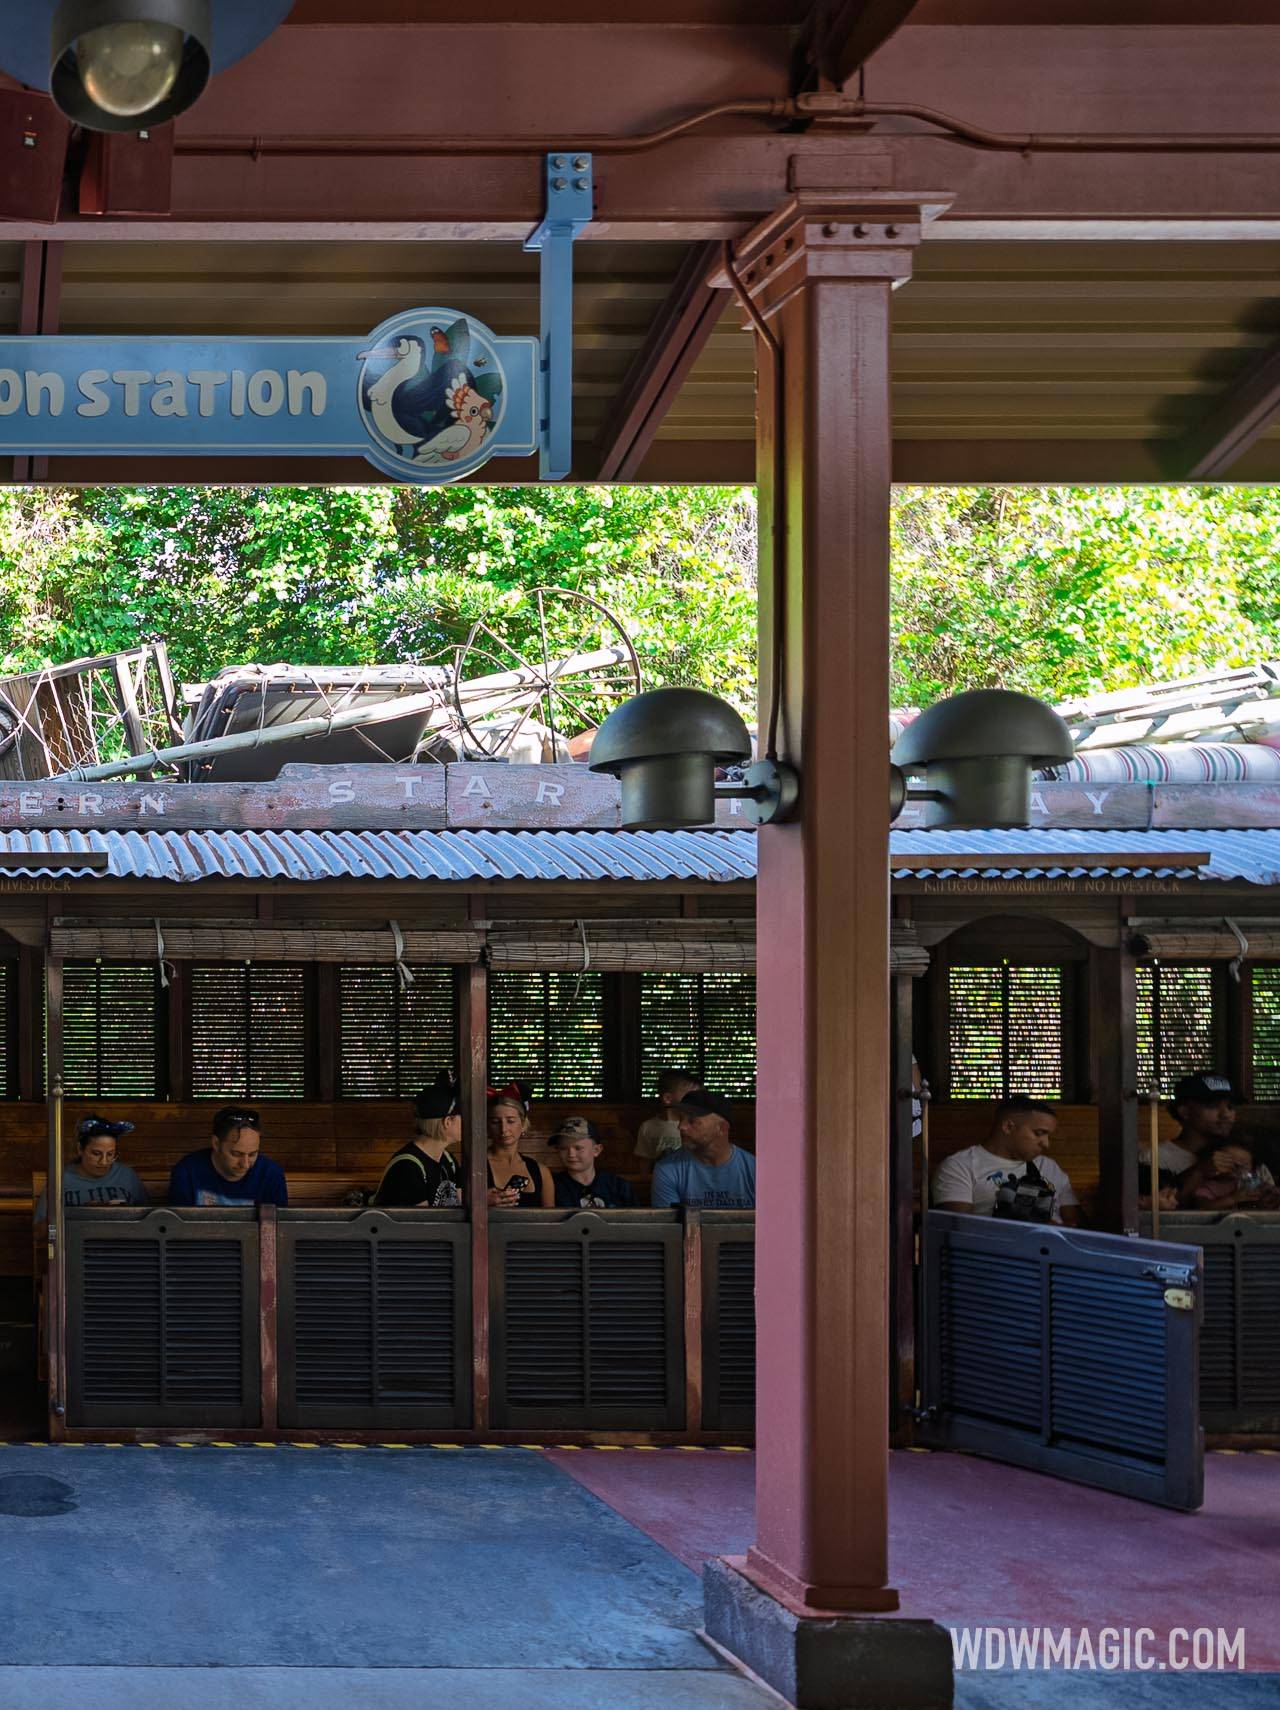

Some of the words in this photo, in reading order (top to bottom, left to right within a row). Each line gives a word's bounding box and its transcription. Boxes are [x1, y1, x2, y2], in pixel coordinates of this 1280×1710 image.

[328, 775, 565, 806] STAR
[0, 878, 71, 891] LIVESTOCK
[1085, 879, 1106, 892] NO
[1110, 879, 1180, 892] LIVESTOCK
